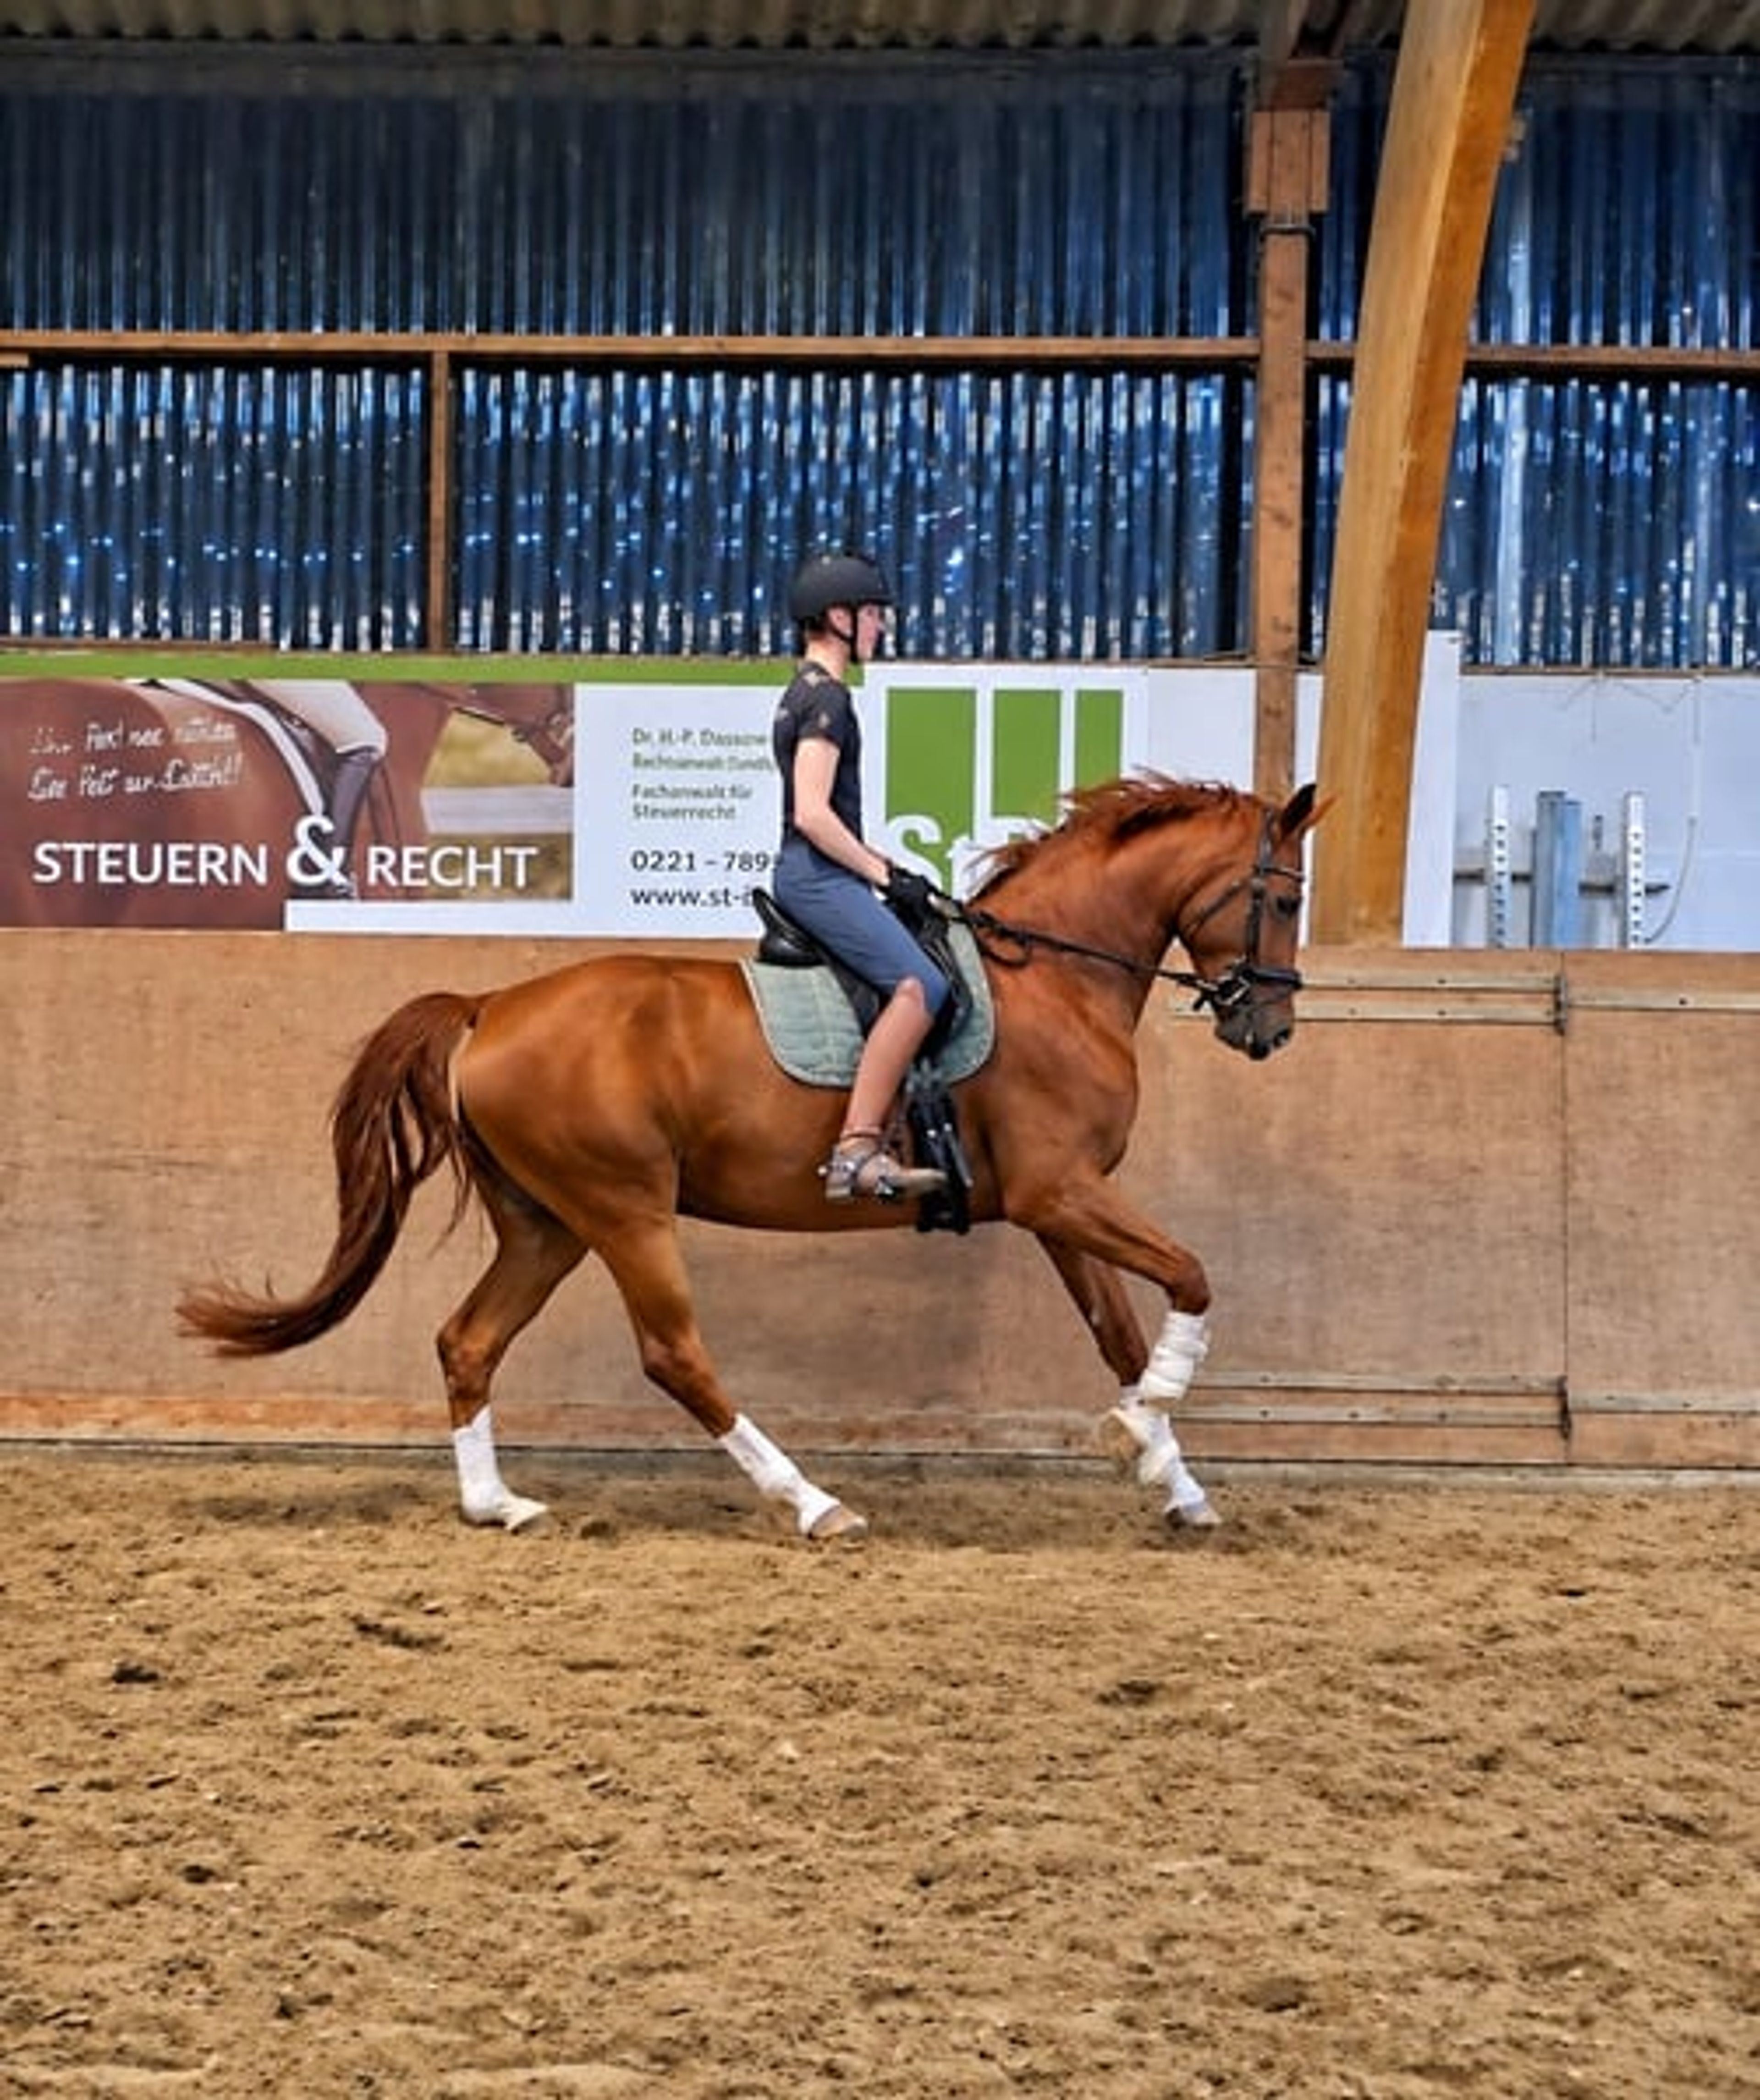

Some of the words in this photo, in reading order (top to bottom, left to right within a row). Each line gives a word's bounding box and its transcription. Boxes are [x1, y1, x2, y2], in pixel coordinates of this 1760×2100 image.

[633, 784, 725, 799] Fachanwalt
[729, 784, 753, 799] für
[632, 805, 736, 820] Steuerrecht
[32, 842, 267, 886] STEUERN
[285, 814, 348, 887] &
[367, 846, 539, 888] RECHT
[631, 850, 696, 871] 0221
[723, 850, 780, 871] 789
